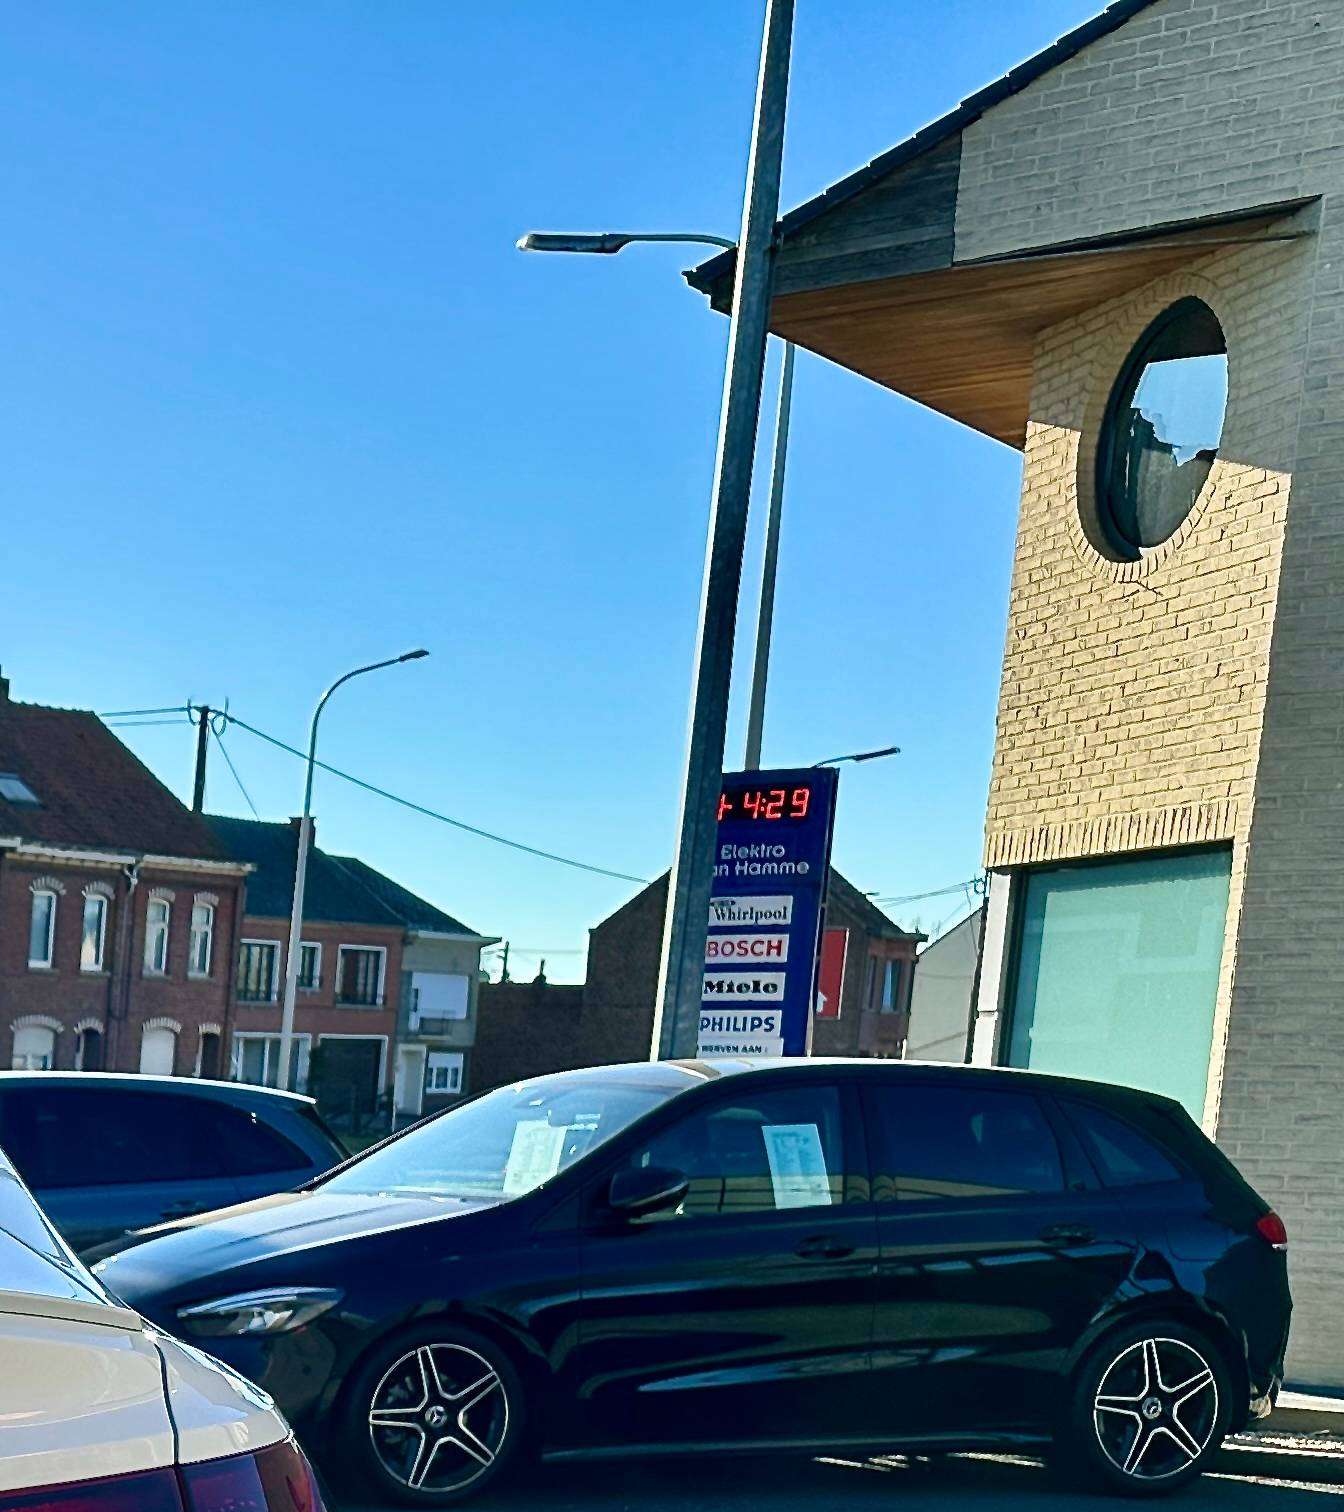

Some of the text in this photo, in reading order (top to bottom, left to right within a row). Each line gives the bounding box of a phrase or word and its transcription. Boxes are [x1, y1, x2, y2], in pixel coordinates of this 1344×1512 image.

[721, 843, 786, 860] Elektro
[735, 860, 810, 876] Hamme
[713, 906, 788, 925] Whirlpool
[707, 939, 783, 957] BOSCH
[703, 979, 778, 995] Miele
[700, 1016, 775, 1033] PHILIPS
